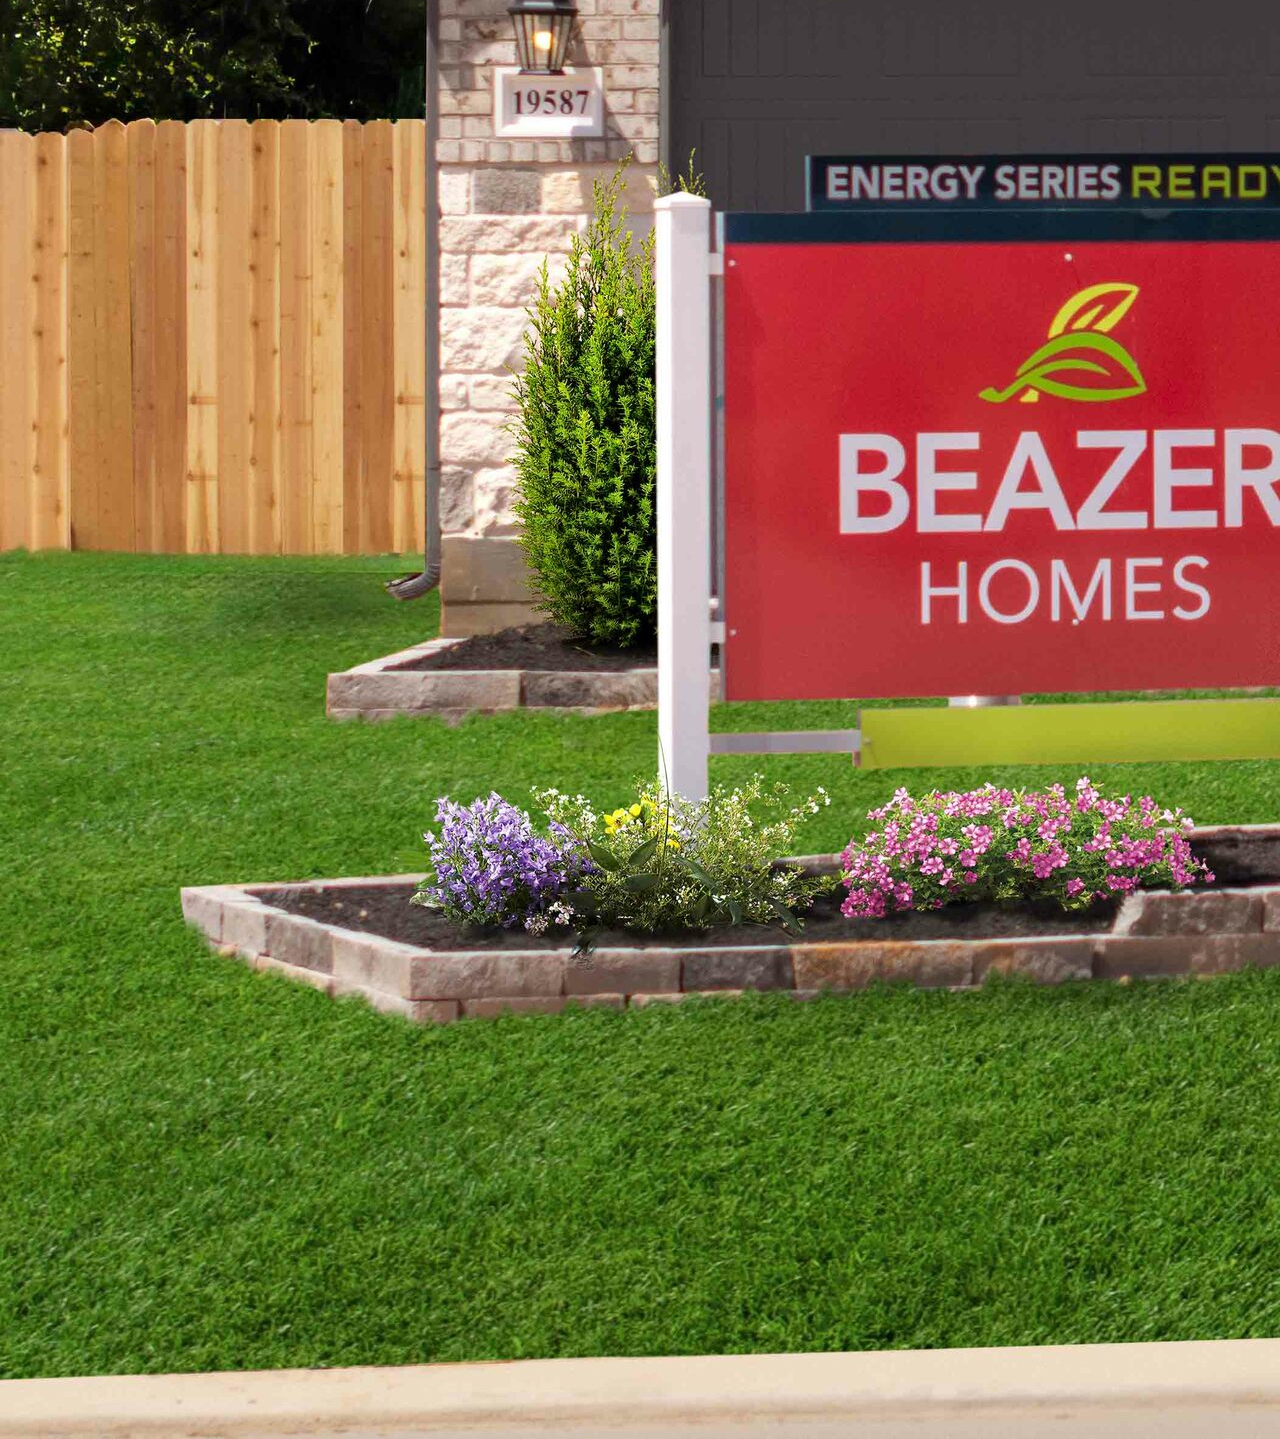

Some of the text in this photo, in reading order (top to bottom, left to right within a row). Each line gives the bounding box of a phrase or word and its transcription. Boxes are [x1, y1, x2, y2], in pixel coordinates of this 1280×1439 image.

[513, 89, 590, 115] 19587
[826, 164, 985, 200] ENERGY
[994, 164, 1121, 200] SERIES
[919, 554, 1212, 626] HOMES
